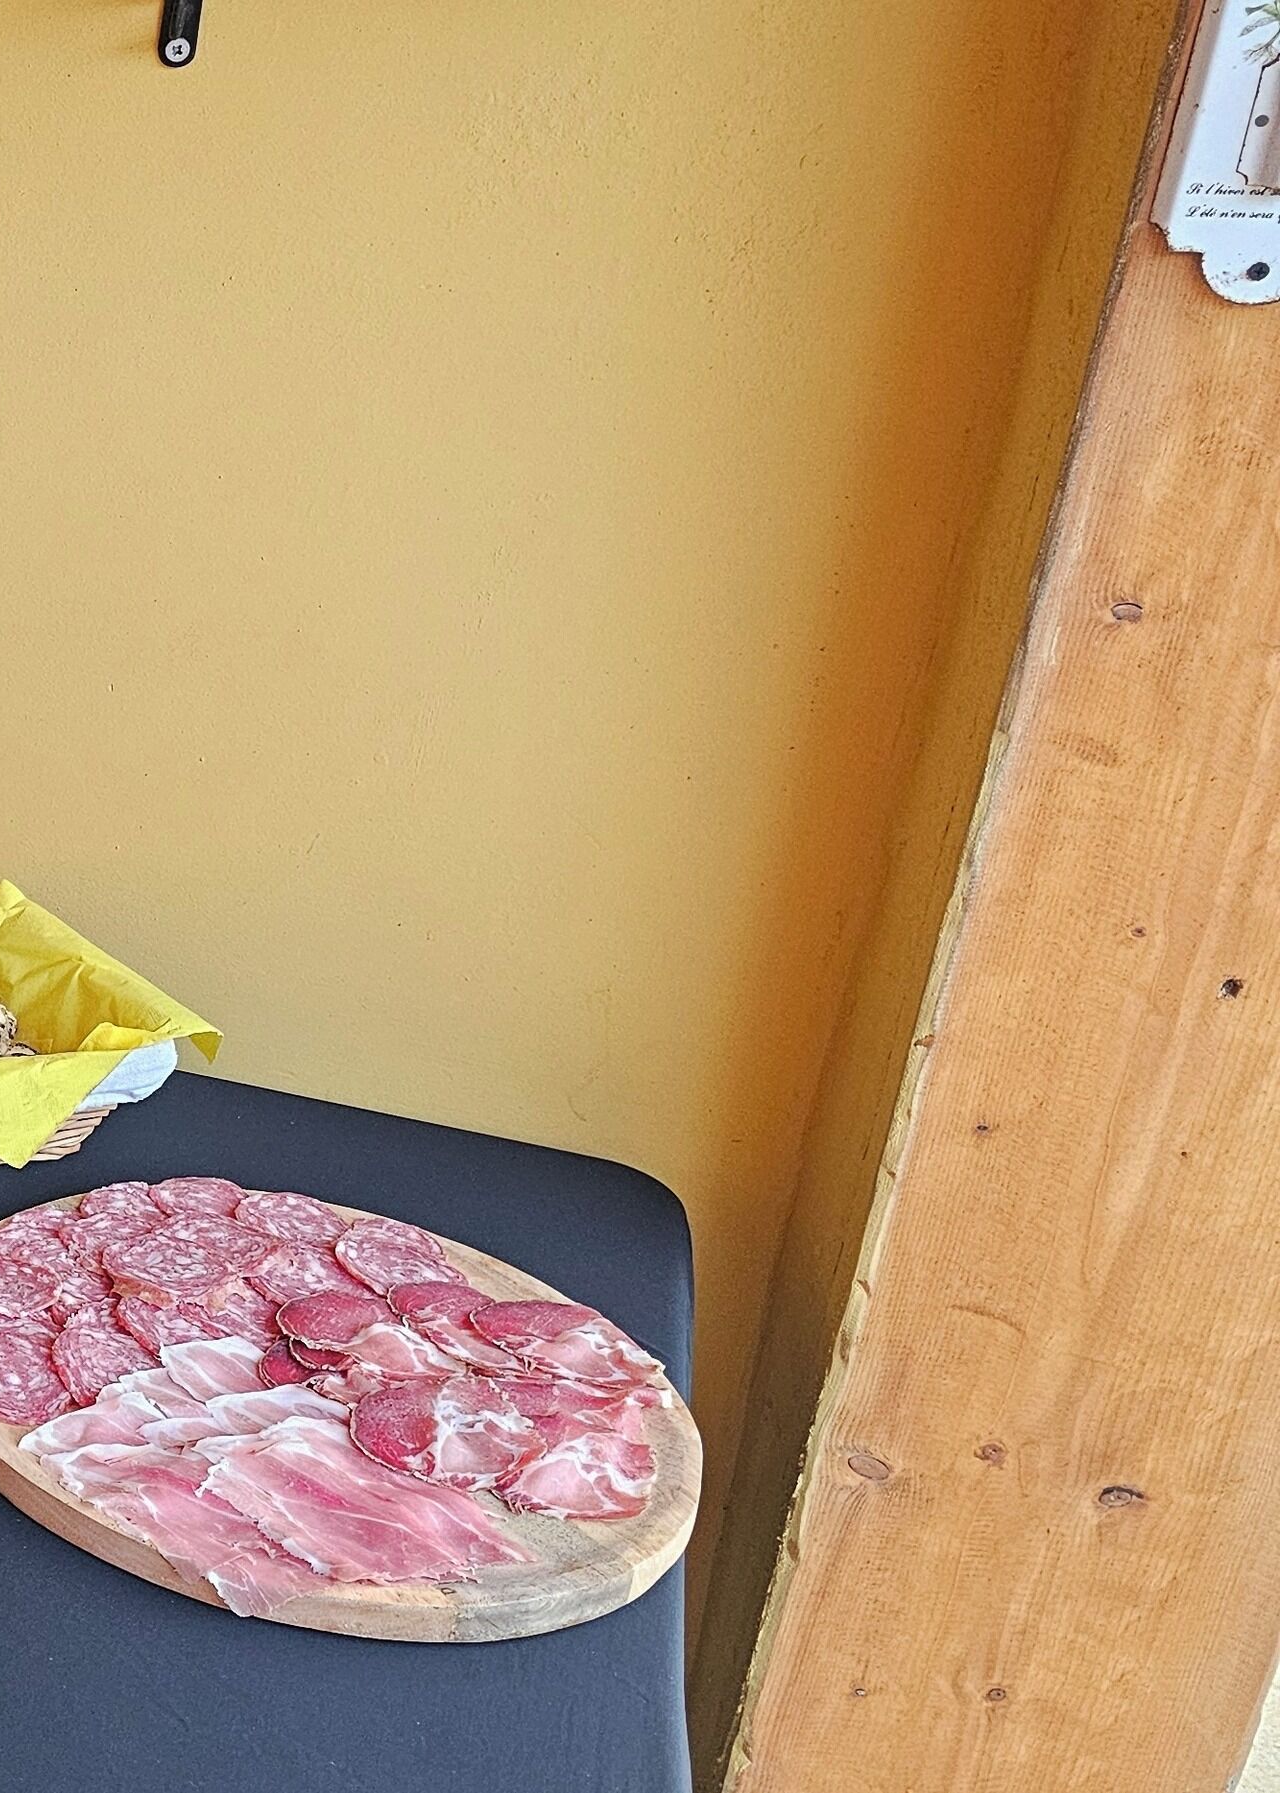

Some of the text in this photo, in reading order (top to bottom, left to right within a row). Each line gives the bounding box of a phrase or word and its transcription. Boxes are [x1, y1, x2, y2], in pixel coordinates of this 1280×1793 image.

[1205, 182, 1245, 195] l'hiver
[1249, 186, 1270, 196] est
[1185, 204, 1217, 218] L'été
[1219, 209, 1246, 218] n'en
[1249, 211, 1274, 219] sera
